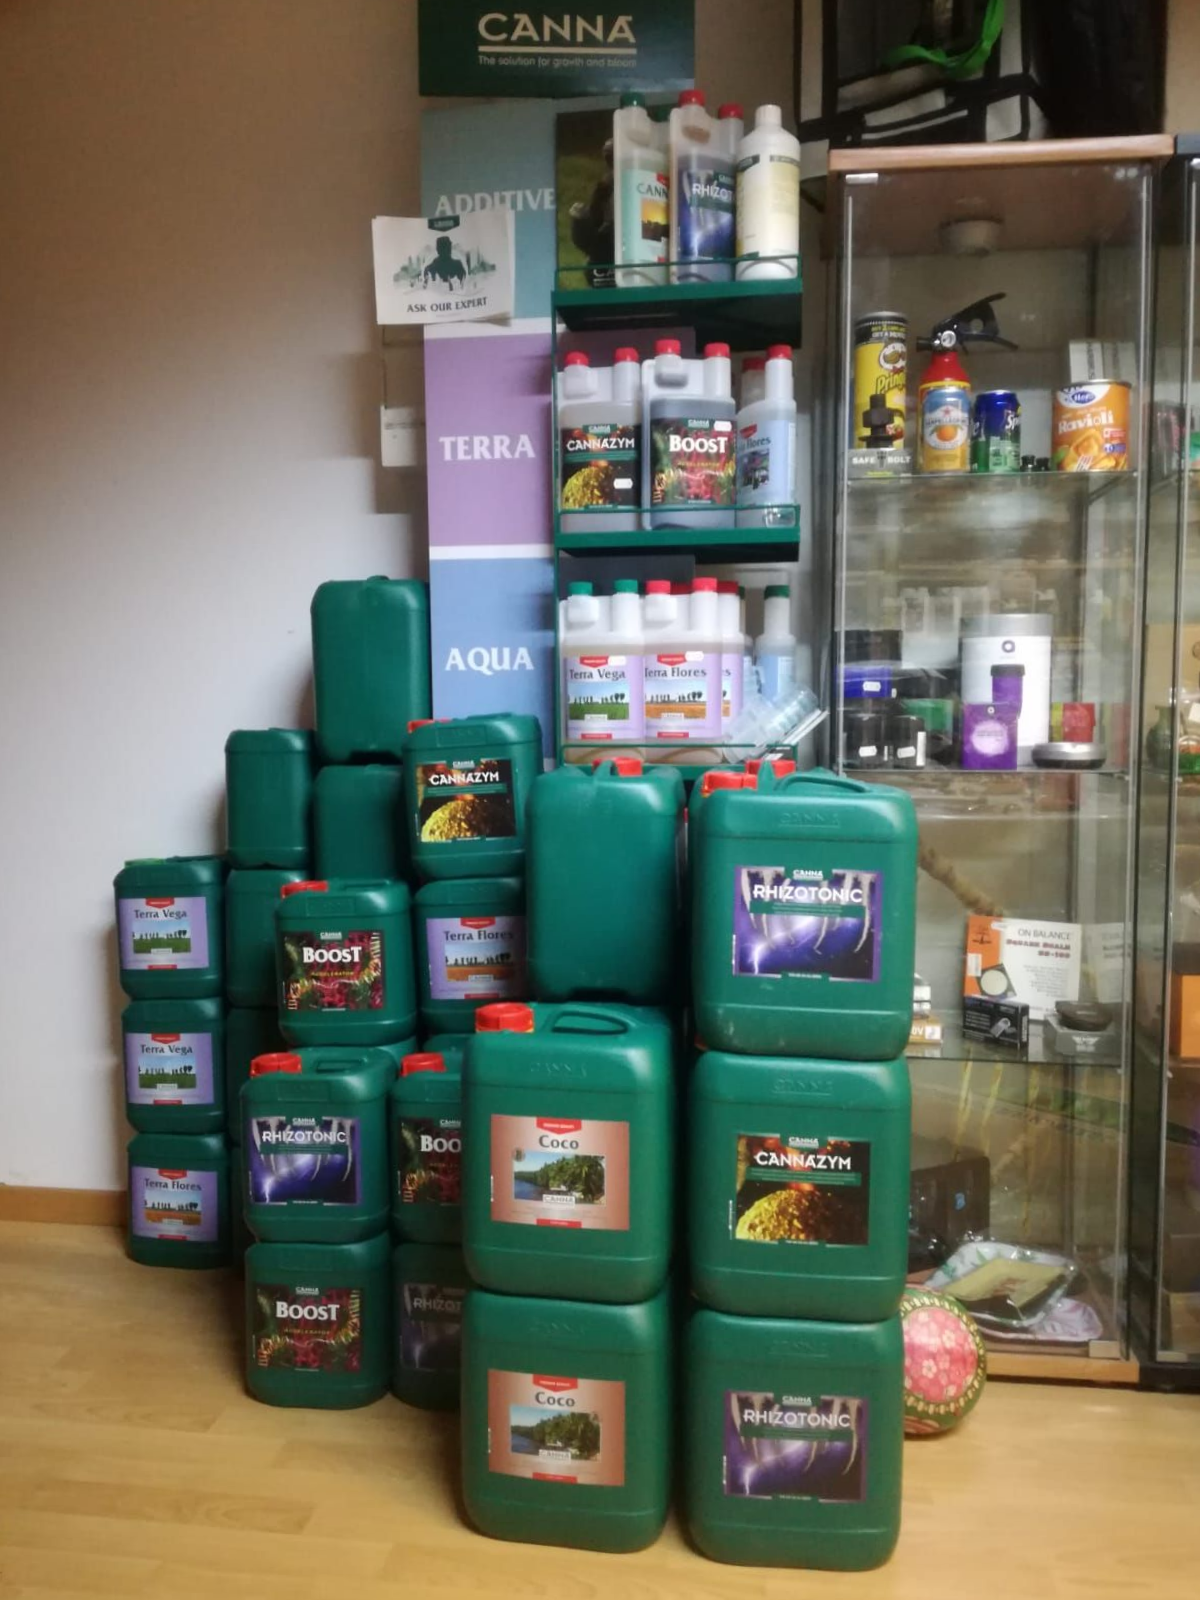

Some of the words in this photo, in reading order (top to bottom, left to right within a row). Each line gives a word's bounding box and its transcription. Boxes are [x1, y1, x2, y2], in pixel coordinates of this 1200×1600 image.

[478, 13, 636, 43] CANNA
[407, 303, 427, 313] ASK
[430, 302, 452, 312] OUR
[455, 297, 487, 310] EXPERT
[1059, 410, 1114, 434] Ravioli
[439, 434, 536, 461] TERRA
[566, 438, 635, 451] CANNAZYM
[852, 456, 875, 464] SAFE
[887, 456, 911, 464] BOLT
[445, 647, 534, 675] AQUA
[569, 669, 593, 680] Terra
[597, 668, 626, 681] Vega
[671, 667, 707, 678] Flores
[429, 771, 500, 786] CANNAZYM
[793, 869, 823, 877] CANNA
[753, 884, 863, 903] RHIZOTONIC
[134, 909, 160, 919] Terra
[162, 909, 188, 920] Vega
[444, 930, 474, 941] Terra
[478, 929, 513, 940] Flores
[1018, 929, 1031, 937] ON
[140, 1044, 164, 1054] Terra
[167, 1044, 193, 1055] Vega
[262, 1131, 347, 1142] RHIZOTONIC
[538, 1134, 579, 1150] Coco
[754, 1151, 852, 1170] CANNAZYM
[144, 1178, 169, 1188] Terra
[171, 1180, 202, 1191] Flores
[535, 1391, 576, 1407] Coco
[743, 1409, 851, 1427] RHIZOTONIC
